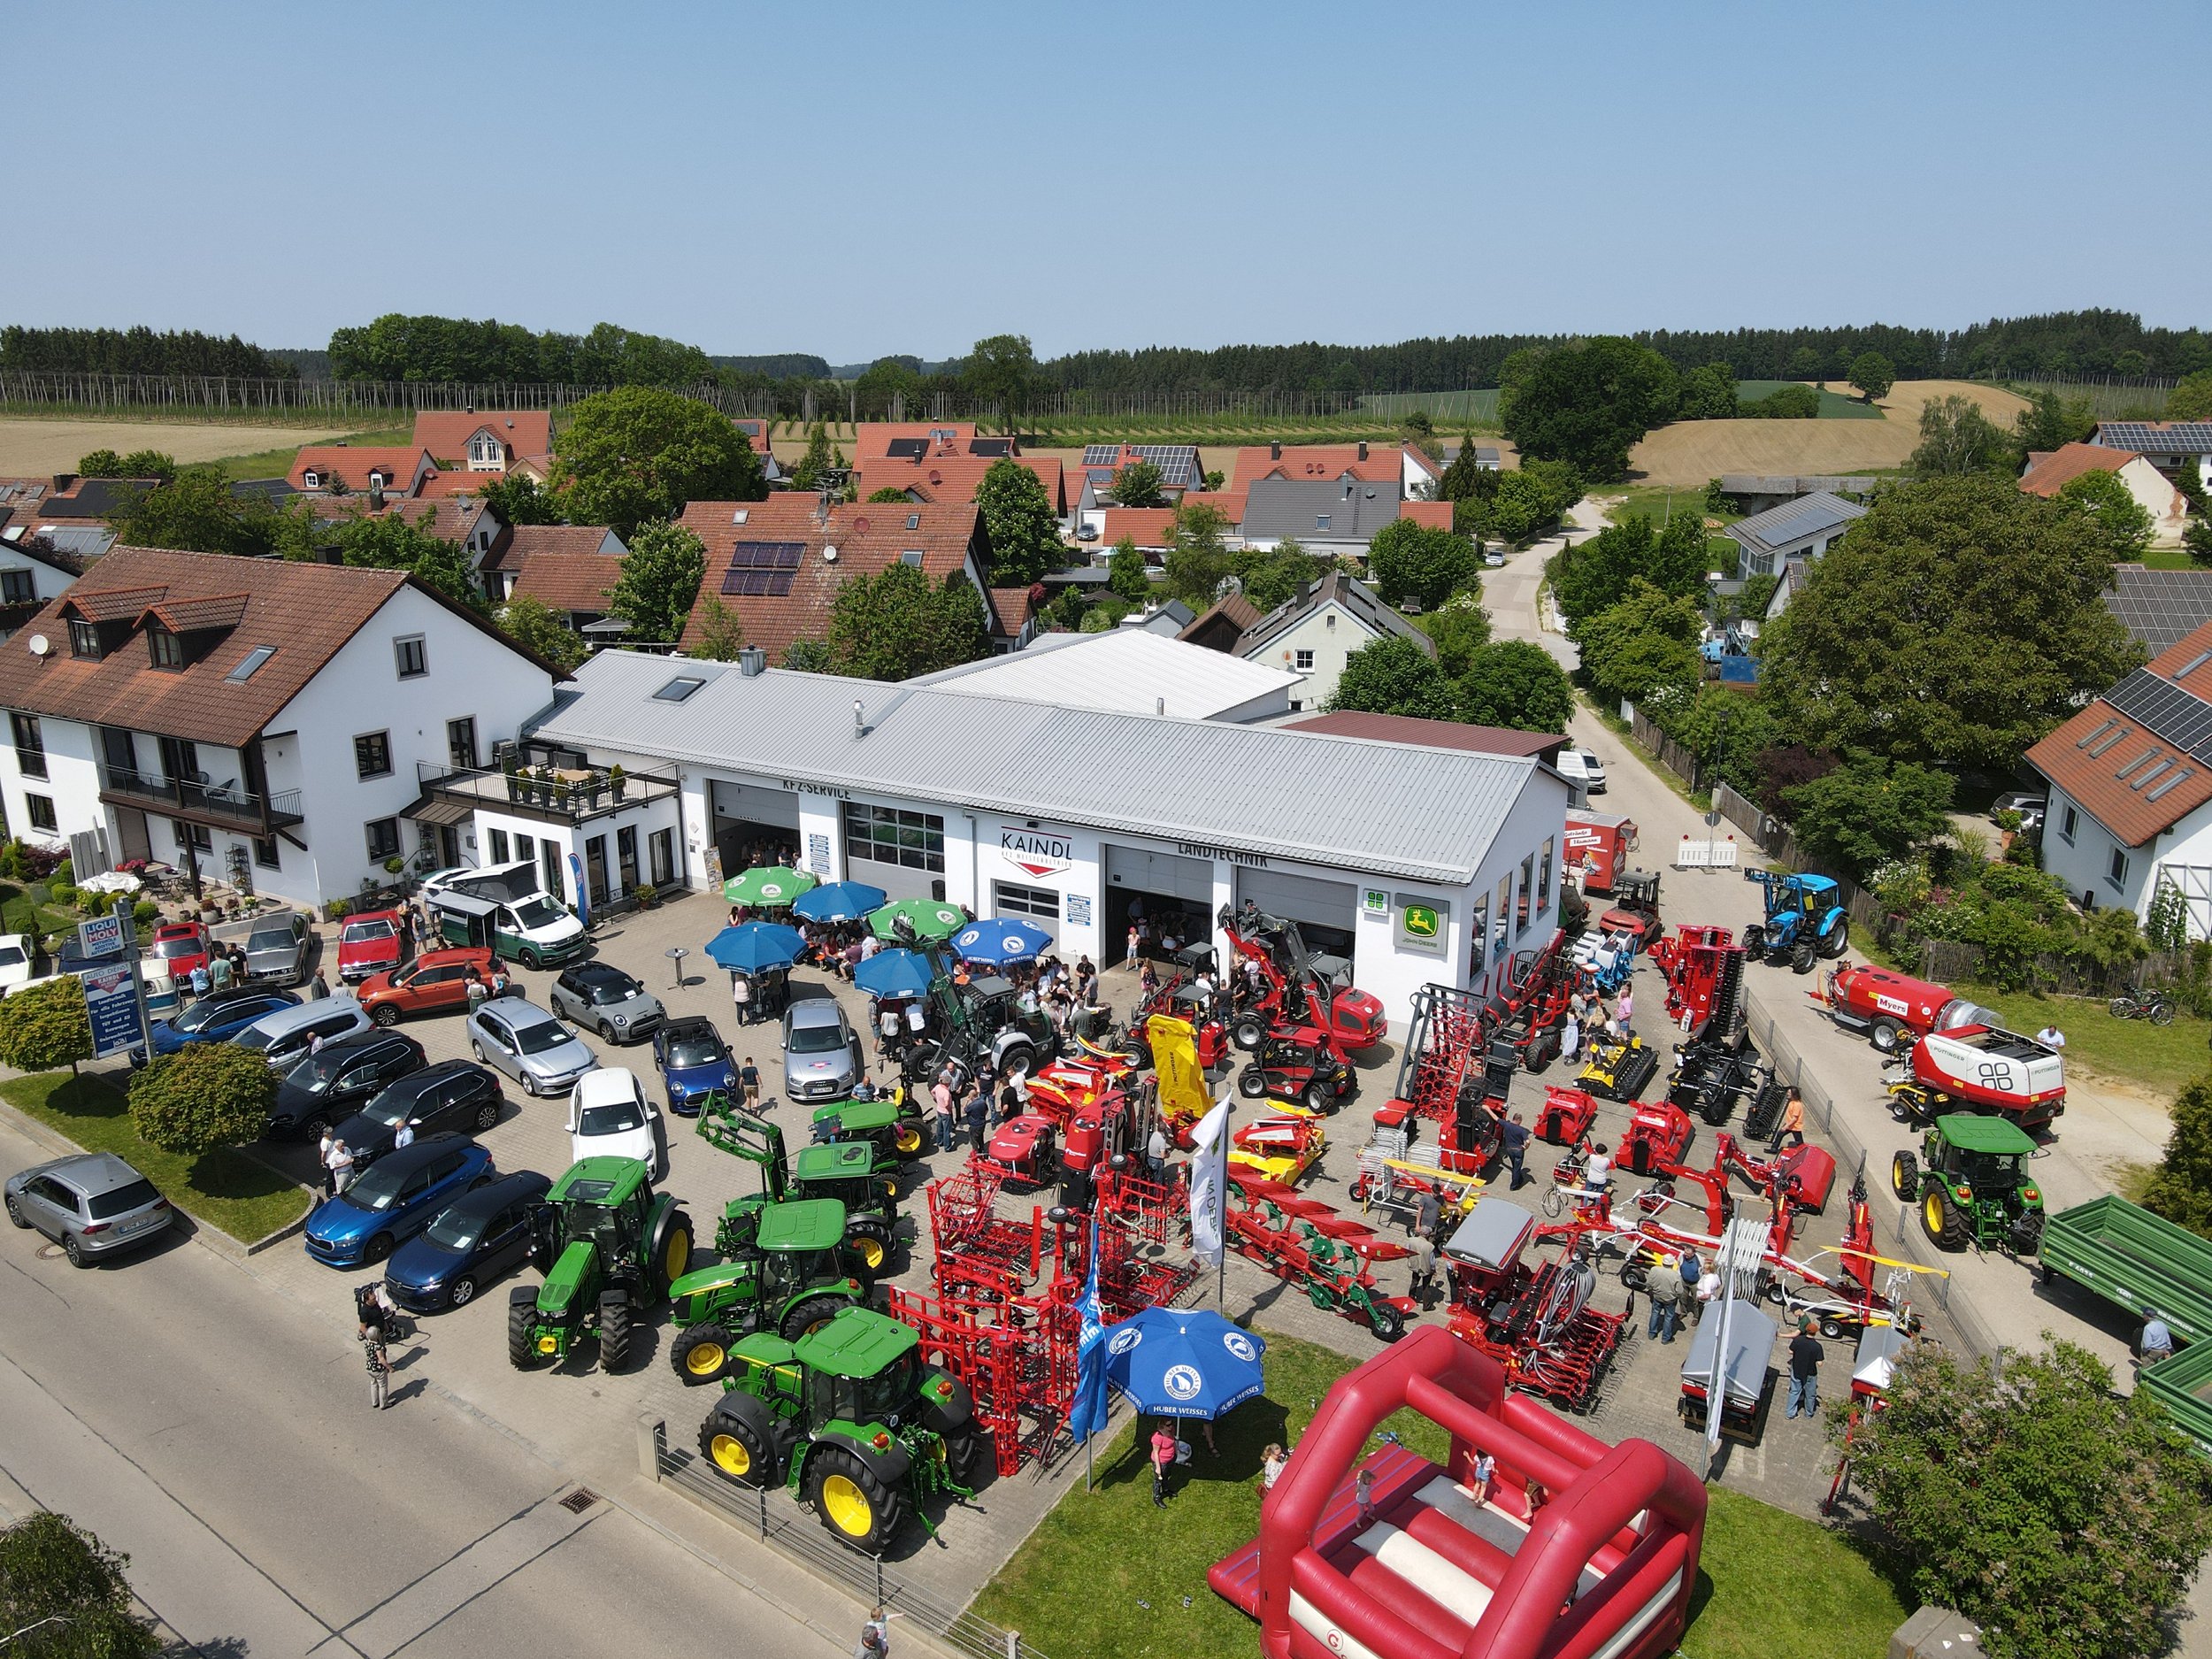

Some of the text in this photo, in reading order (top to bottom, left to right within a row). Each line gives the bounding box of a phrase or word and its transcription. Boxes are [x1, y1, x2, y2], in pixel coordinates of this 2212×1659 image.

[1002, 833, 1072, 860] KAINDL
[87, 919, 116, 933] LIQUI
[88, 927, 117, 941] MOLY
[86, 964, 128, 979] AUTO DIENST
[98, 973, 119, 984] KAINDL
[1879, 998, 1906, 1013] Myers
[1165, 1366, 1200, 1387] HUBER WEISSES
[1124, 1387, 1142, 1408] WEISSES
[1179, 1407, 1208, 1417] WEISSES
[1328, 1633, 1340, 1647] G
